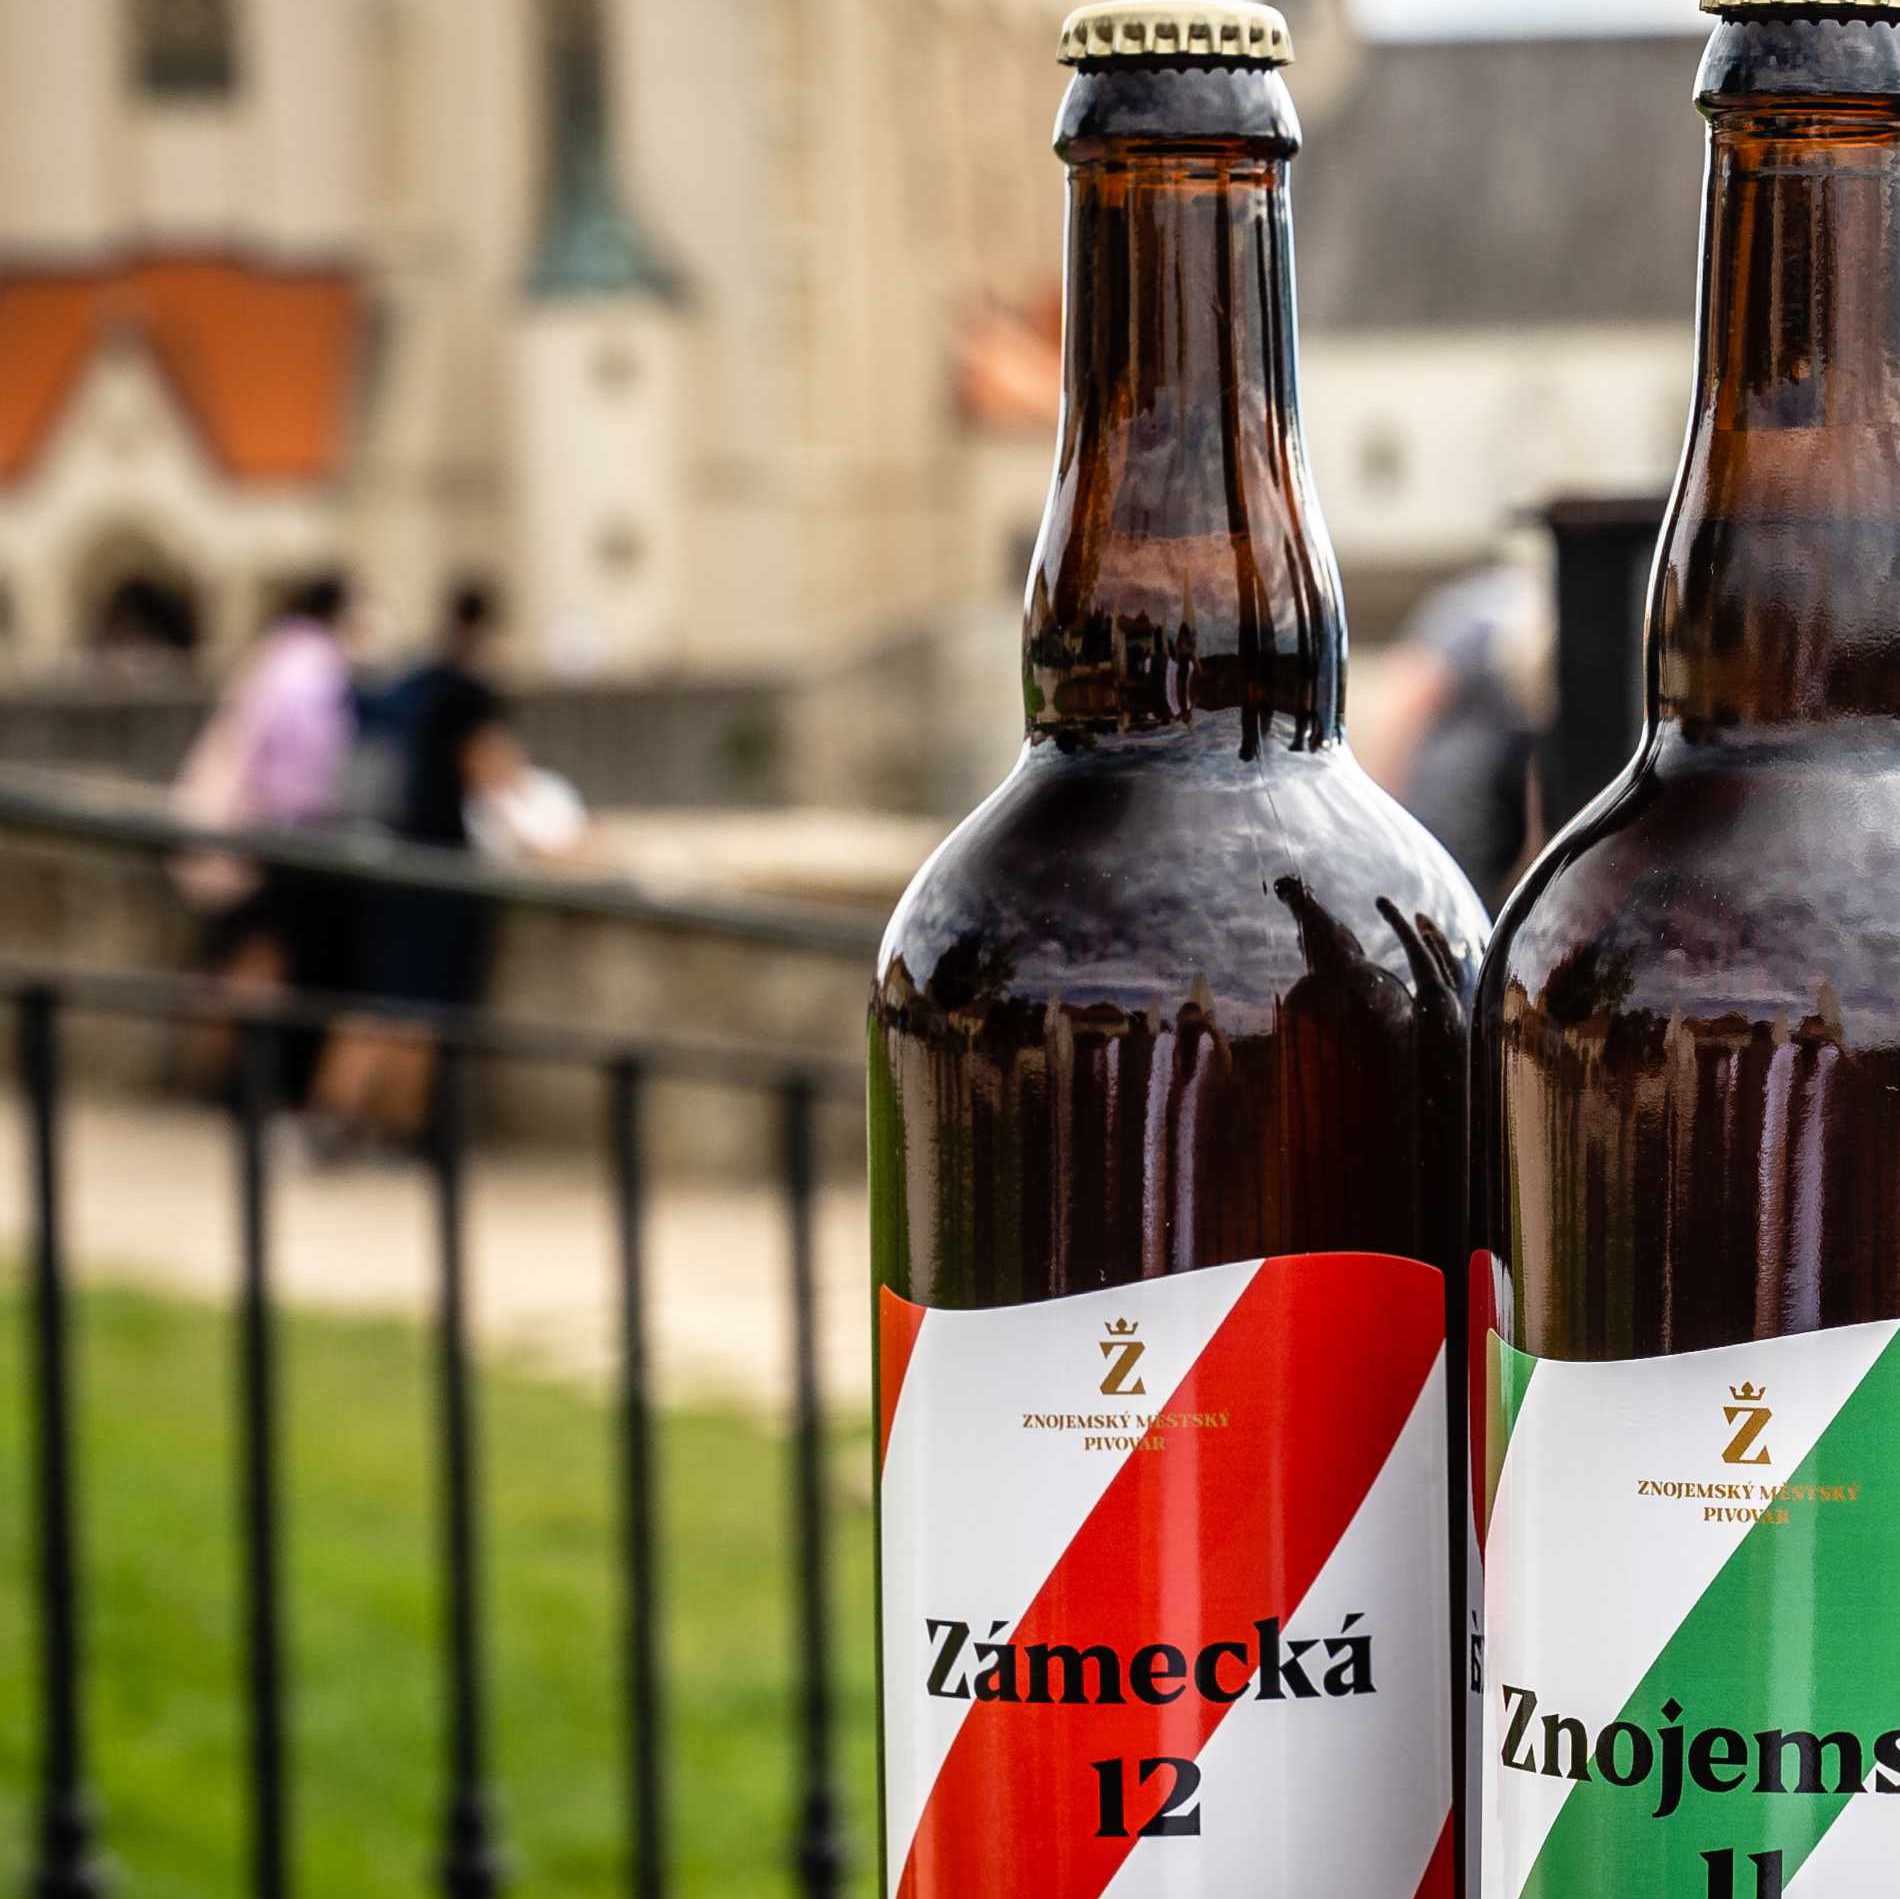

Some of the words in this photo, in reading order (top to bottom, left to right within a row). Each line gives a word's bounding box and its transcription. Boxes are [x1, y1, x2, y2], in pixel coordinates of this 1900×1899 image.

[1023, 1410, 1131, 1430] ZNOJEMSKÝ
[1136, 1410, 1231, 1429] MĚSTSKÝ
[1084, 1435, 1166, 1452] PIVOVAR
[1637, 1479, 1754, 1501] ZNOJEMSKÝ
[1760, 1480, 1861, 1502] MĚSTSKÝ
[1703, 1506, 1790, 1525] PIVOVAR
[925, 1612, 1377, 1705] Zámecká
[1090, 1756, 1202, 1838] 12
